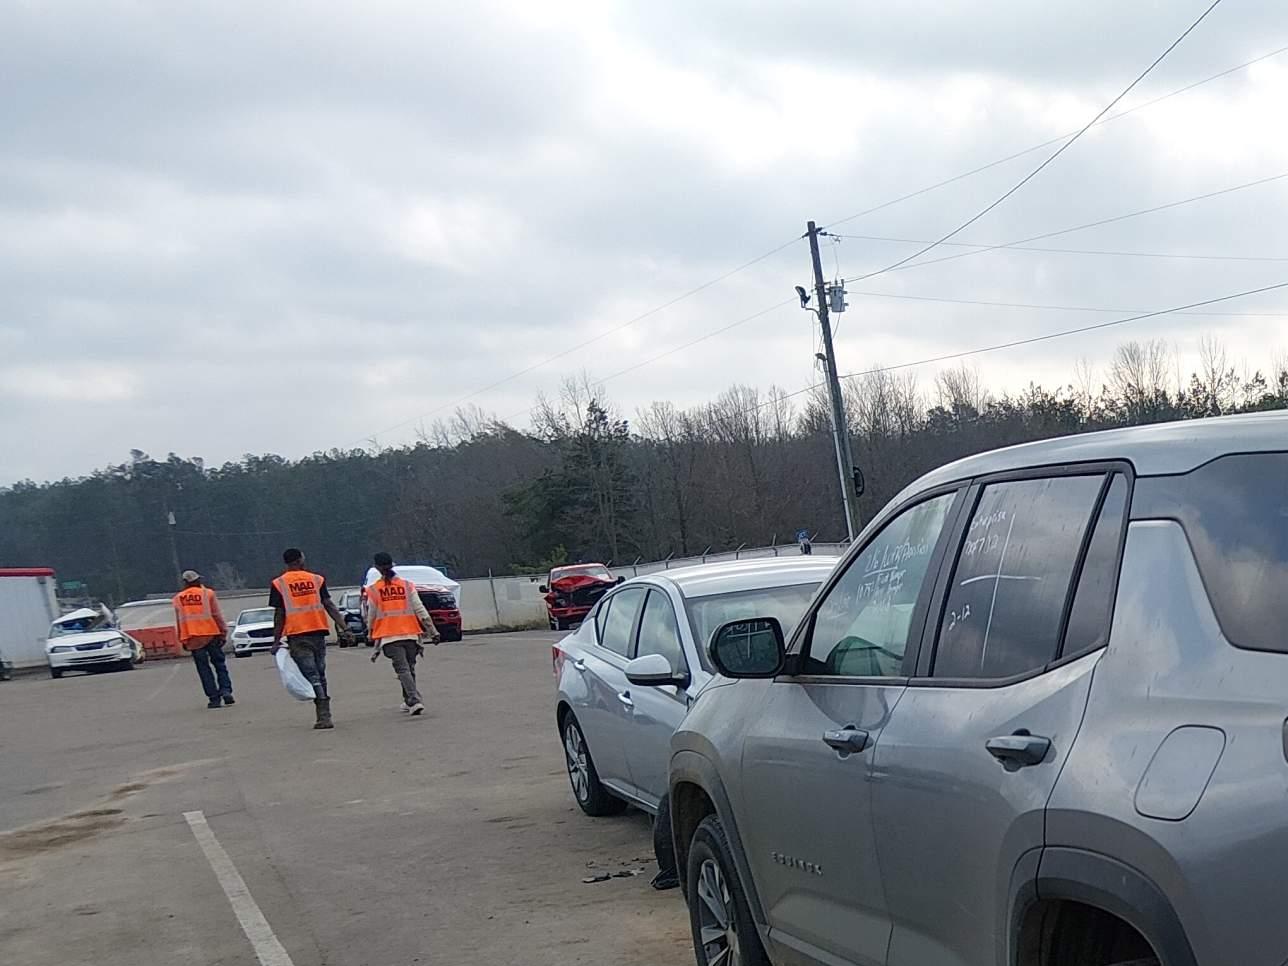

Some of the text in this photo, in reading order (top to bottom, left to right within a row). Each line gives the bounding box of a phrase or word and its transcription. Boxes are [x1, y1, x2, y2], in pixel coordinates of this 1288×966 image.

[288, 581, 315, 593] MAD
[379, 586, 405, 598] MAD
[179, 594, 202, 605] MAD
[771, 851, 822, 875] EQUINOX
